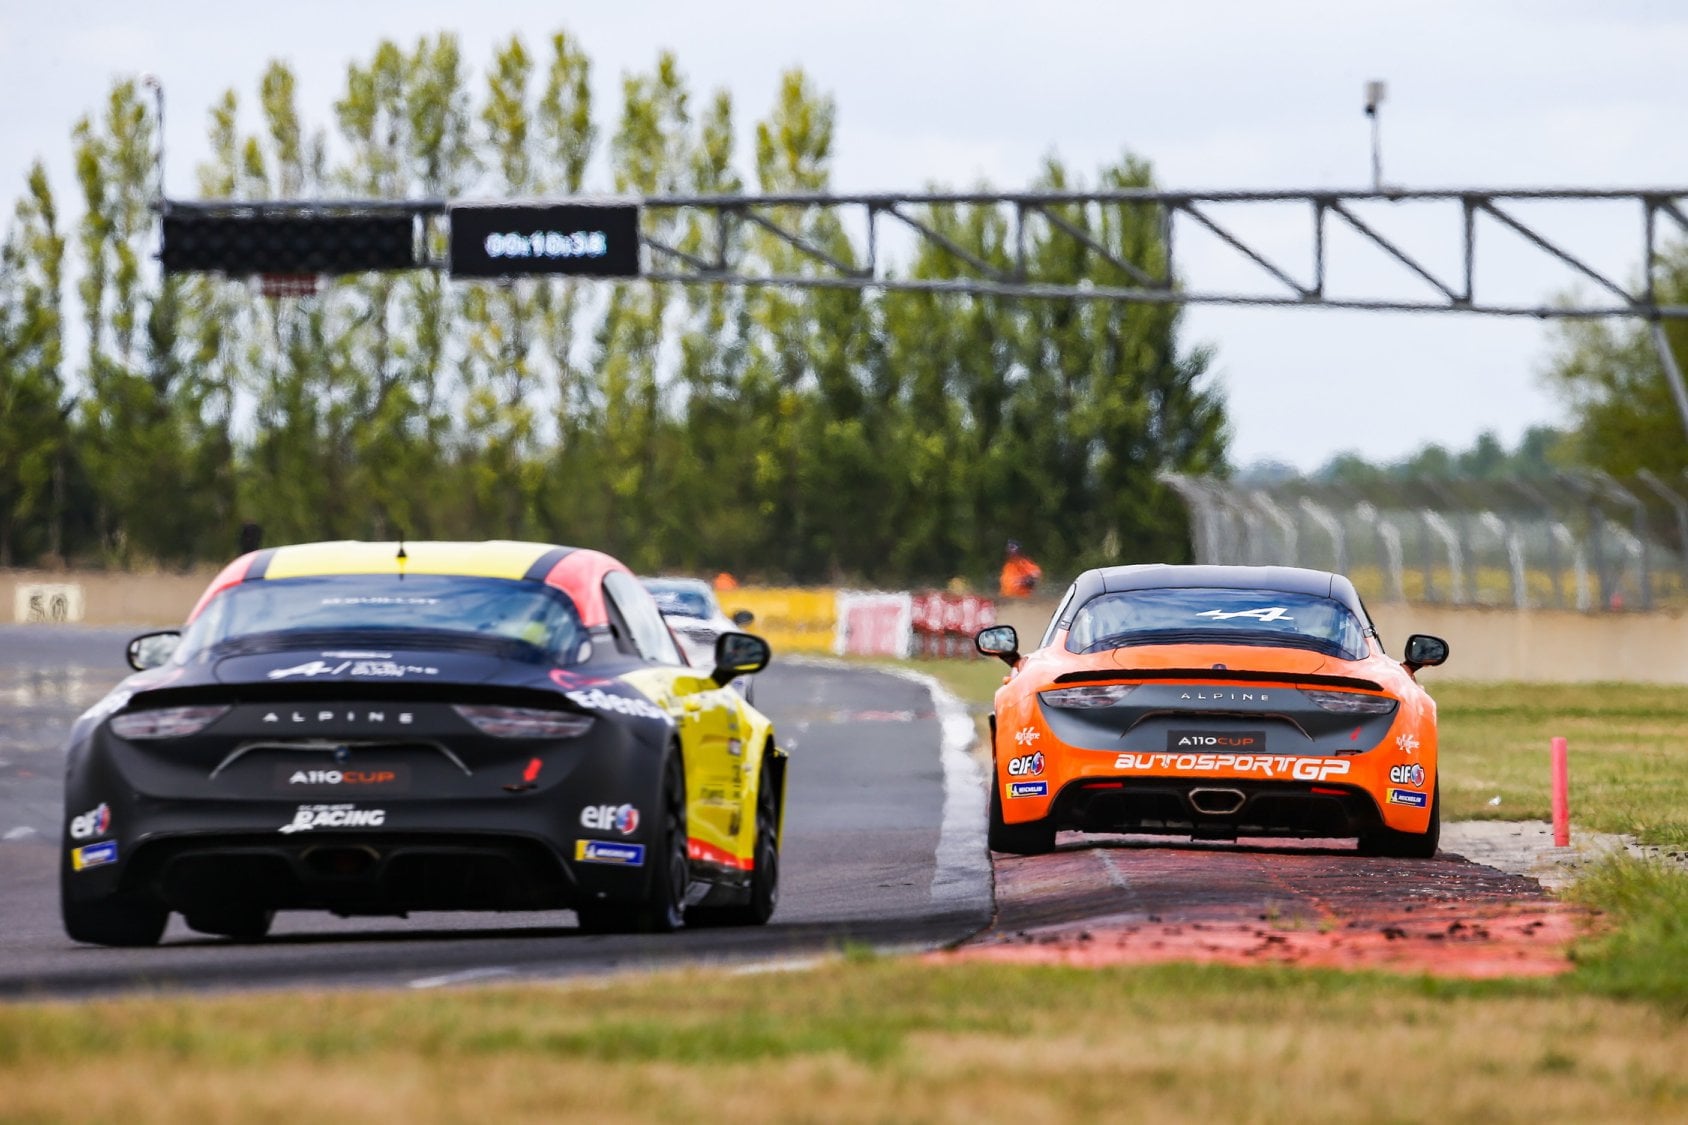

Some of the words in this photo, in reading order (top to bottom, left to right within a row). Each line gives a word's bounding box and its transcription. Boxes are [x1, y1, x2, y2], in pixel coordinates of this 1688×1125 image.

[1180, 692, 1269, 701] ALPINE
[262, 711, 413, 724] ALPINE
[1008, 755, 1033, 775] elf
[1390, 765, 1412, 783] elf
[278, 809, 386, 834] RACING
[580, 804, 618, 831] elf
